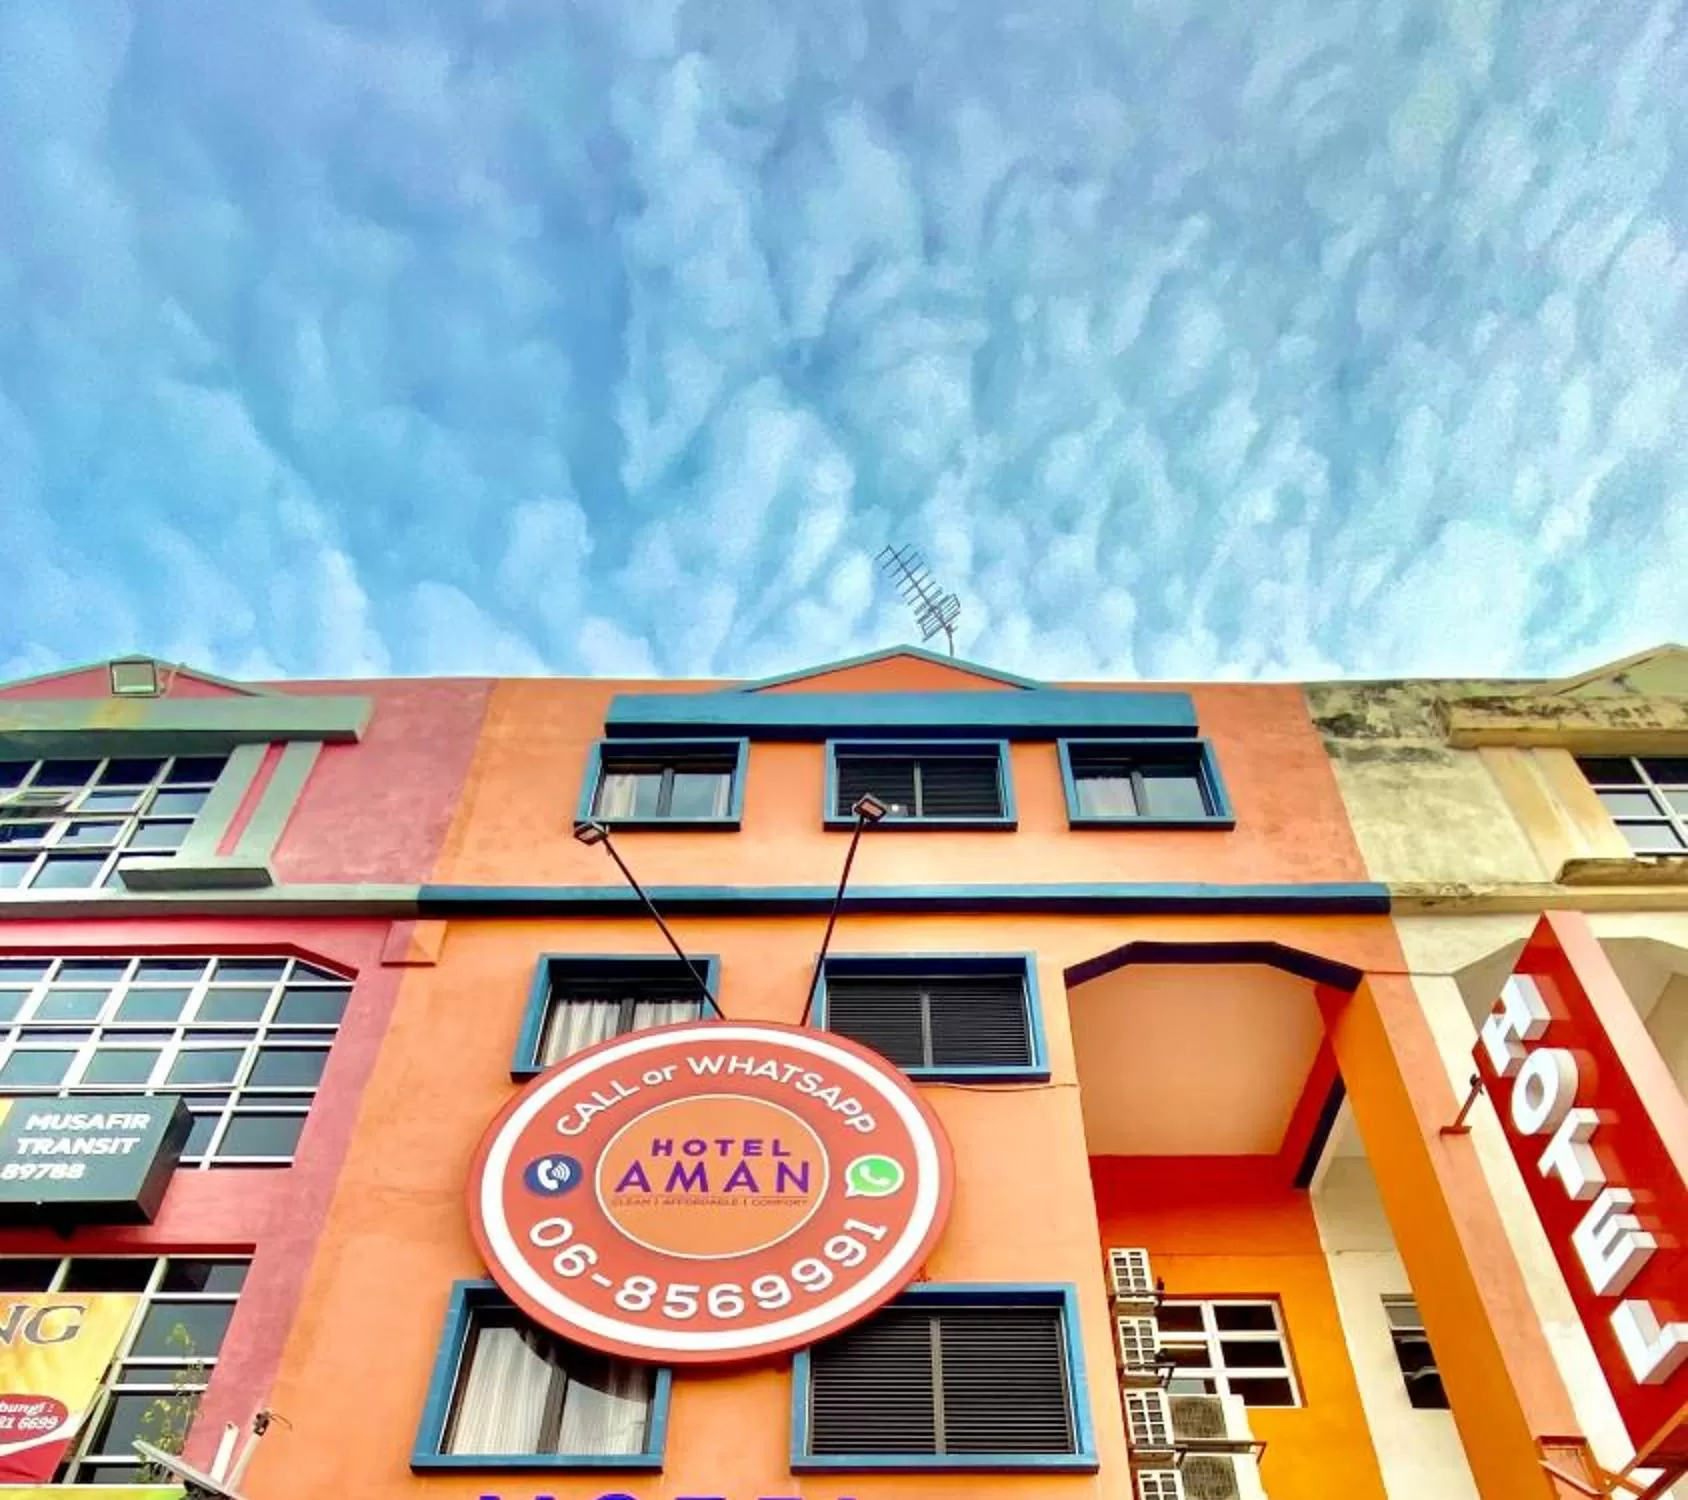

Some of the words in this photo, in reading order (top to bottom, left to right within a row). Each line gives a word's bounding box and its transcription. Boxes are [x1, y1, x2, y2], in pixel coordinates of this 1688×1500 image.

[555, 1079, 641, 1137] CALL
[642, 1064, 679, 1087] or
[686, 1055, 877, 1135] WHATSAPP
[25, 1113, 151, 1131] MUSAFIR
[17, 1137, 141, 1155] TRANSIT
[651, 1138, 791, 1157] HOTEL
[614, 1160, 810, 1193] AMAN
[1480, 973, 1688, 1386] HOTEL
[528, 1217, 889, 1321] 06-8569991
